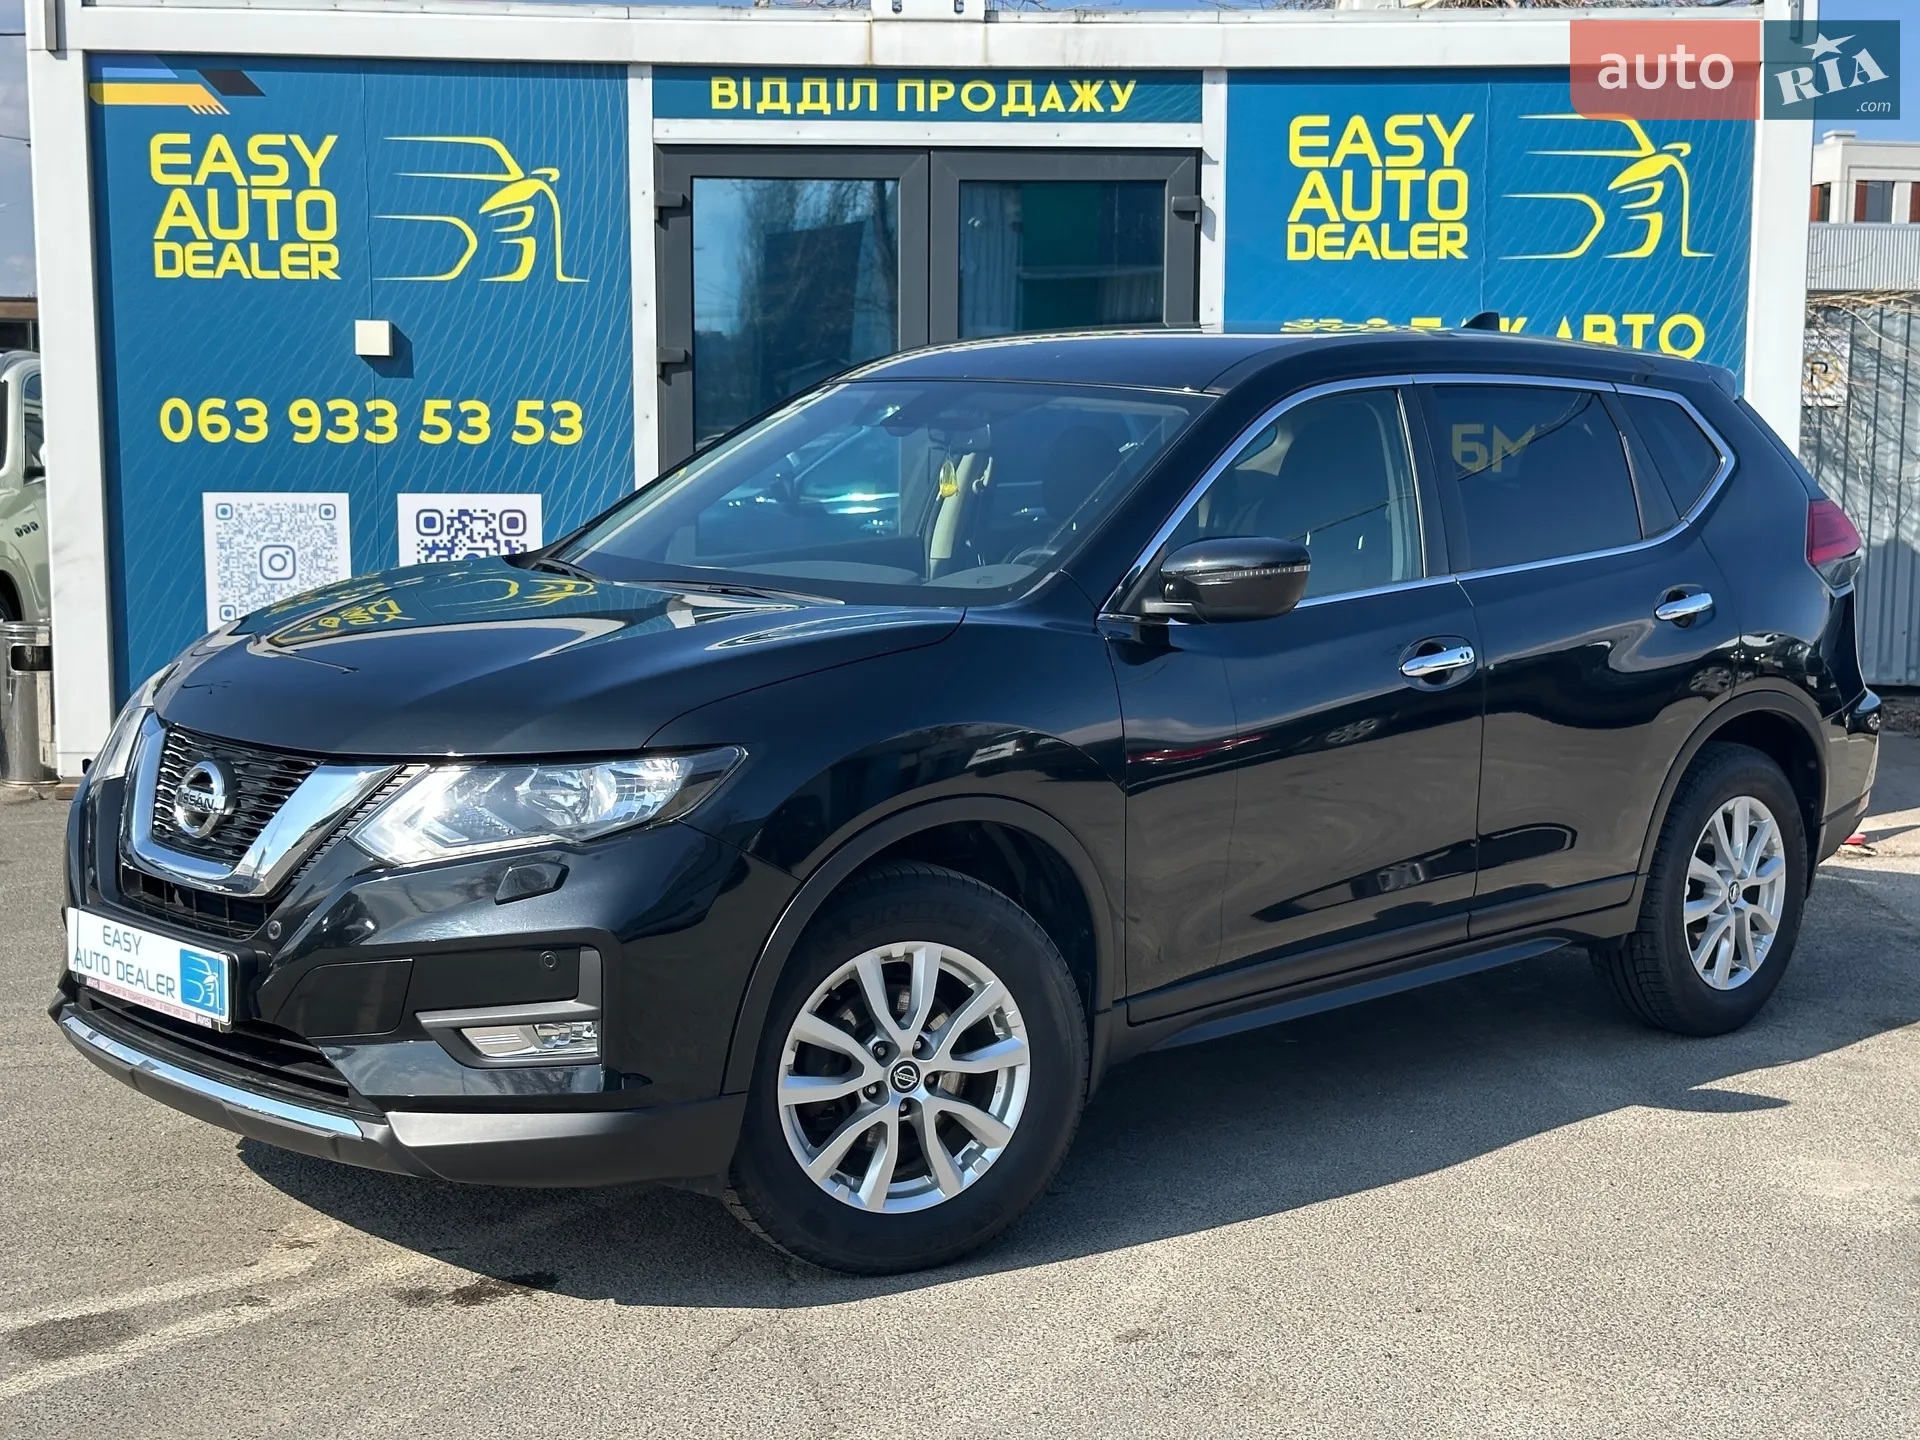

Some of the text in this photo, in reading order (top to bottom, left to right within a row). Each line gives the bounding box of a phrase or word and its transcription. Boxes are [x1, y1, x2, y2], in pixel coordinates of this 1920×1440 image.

[710, 78, 1137, 117] ВІДДІЛ ПРОДАЖУ
[150, 133, 338, 187] EASY
[1288, 113, 1474, 168] EASY
[154, 188, 338, 241] AUTO
[1288, 168, 1468, 222] AUTO
[154, 242, 342, 281] DEALER
[1286, 222, 1468, 261] DEALER
[159, 398, 583, 446] 063 933 53 53
[103, 924, 142, 956] EASY
[73, 946, 176, 999] AUTO DEALER
